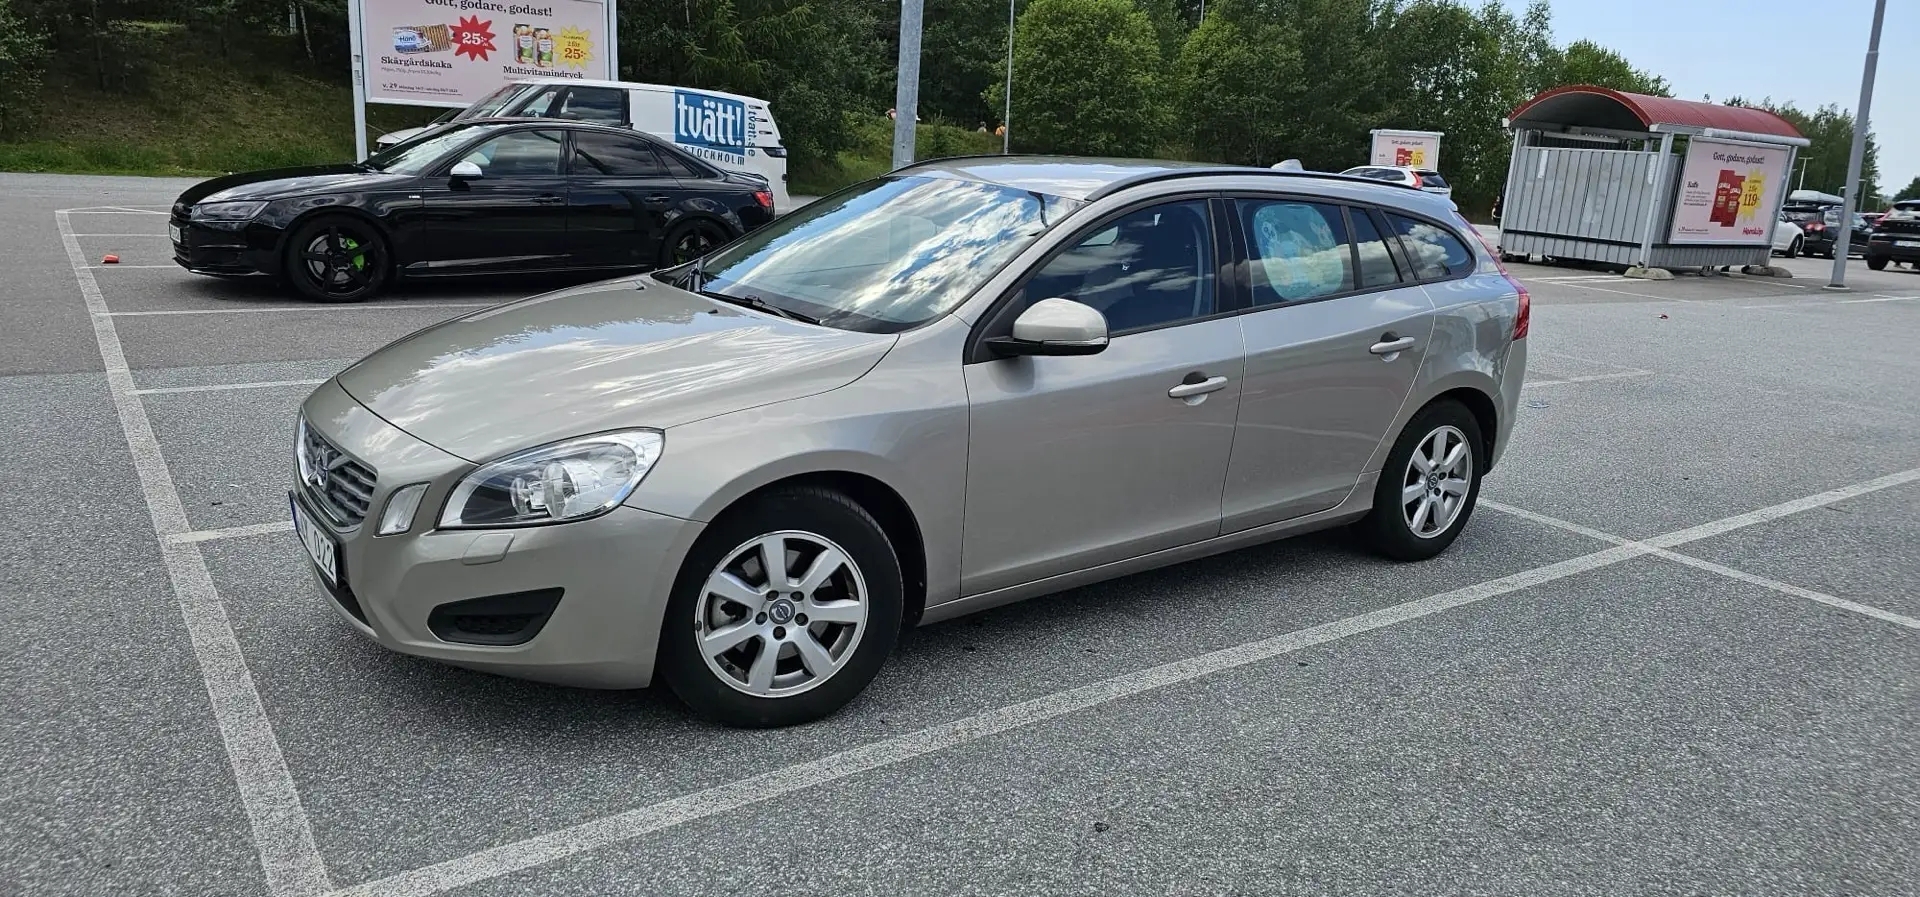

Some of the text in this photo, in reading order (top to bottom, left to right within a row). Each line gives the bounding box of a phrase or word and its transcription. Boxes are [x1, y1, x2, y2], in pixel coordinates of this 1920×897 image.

[460, 0, 507, 13] godare,
[509, 4, 553, 17] godast!
[381, 56, 453, 69] Skärgårdskaka
[503, 65, 584, 80] Multivitamindryck
[677, 94, 743, 146] tvätt!
[747, 110, 757, 157] tvatt.se
[683, 145, 745, 166] STOCKHOLM
